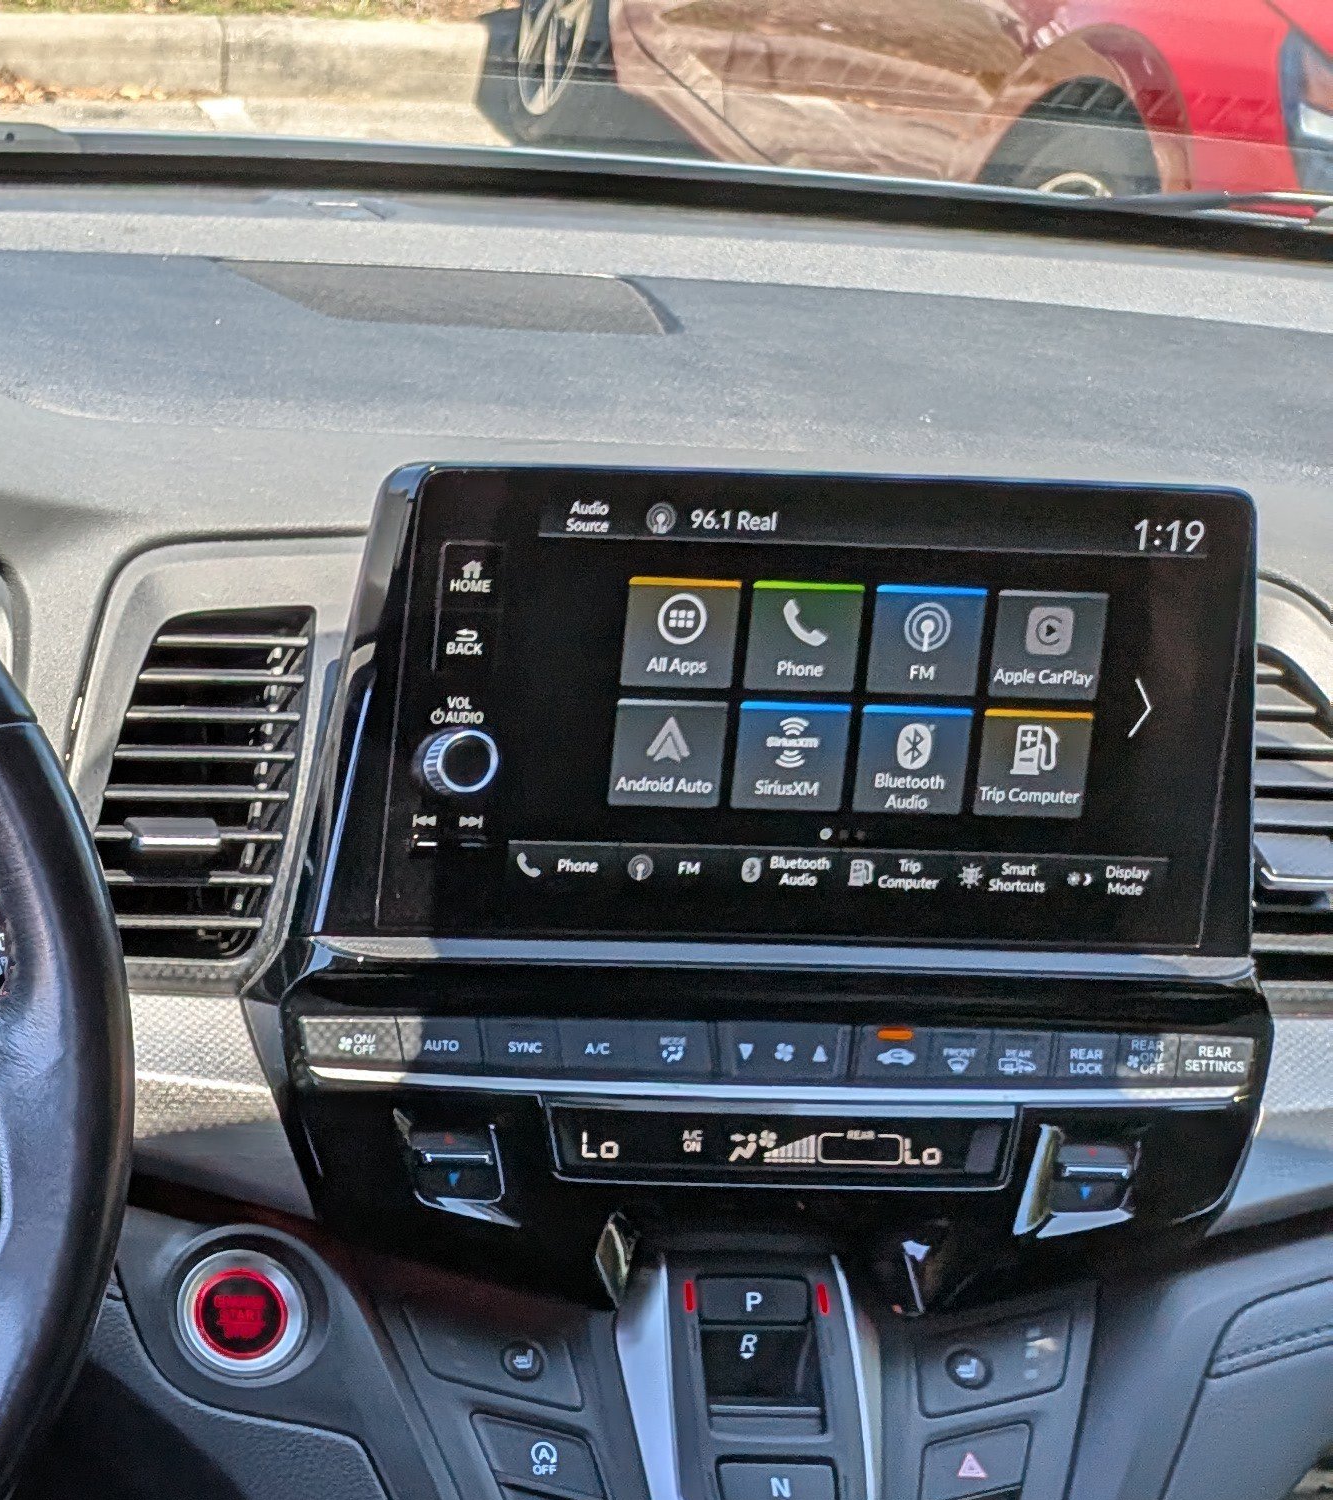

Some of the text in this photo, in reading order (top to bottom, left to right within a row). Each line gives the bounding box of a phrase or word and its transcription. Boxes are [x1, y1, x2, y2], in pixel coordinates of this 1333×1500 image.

[569, 500, 609, 516] Audio
[566, 518, 609, 533] Source
[690, 509, 778, 532] 96.1 Real
[1134, 518, 1206, 552] 1:19
[449, 578, 492, 594] HOME
[445, 641, 483, 656] BACK
[646, 657, 708, 677] All Apps
[776, 660, 824, 677] Phone
[908, 664, 935, 681] FM
[993, 667, 1093, 689] Apple CarPlay
[446, 695, 472, 710] VOL
[444, 710, 484, 725] AUDIO
[615, 776, 713, 795] Android Auto
[754, 779, 820, 798] SiriusXM
[874, 772, 945, 790] Bluetooth
[884, 793, 928, 810] Audio
[979, 786, 1080, 807] Trip Computer
[557, 859, 598, 873] Phone
[677, 861, 701, 875] FM
[769, 855, 831, 870] Bluetooth
[898, 858, 922, 876] Trip
[1000, 862, 1037, 877] Smart
[779, 873, 818, 887] Audio
[1104, 865, 1150, 882] Display
[877, 875, 940, 891] Computer
[987, 878, 1046, 894] Shortcuts
[1107, 882, 1144, 897] Mode
[353, 1033, 376, 1045] ON/
[423, 1039, 460, 1052] AUTO
[1131, 1038, 1165, 1053] REAR
[353, 1044, 377, 1056] OFF
[507, 1041, 543, 1054] SYNC
[584, 1042, 611, 1055] A/C
[1069, 1048, 1103, 1061] REAR
[1197, 1044, 1232, 1058] REAR
[1069, 1062, 1103, 1075] LOCK
[1140, 1063, 1165, 1076] OFF
[1184, 1059, 1245, 1074] SETTINGS
[682, 1129, 704, 1141] A/C
[683, 1140, 702, 1153] ON
[744, 1291, 763, 1313] P
[739, 1333, 759, 1353] R
[532, 1464, 558, 1476] OFF
[770, 1476, 792, 1499] N
